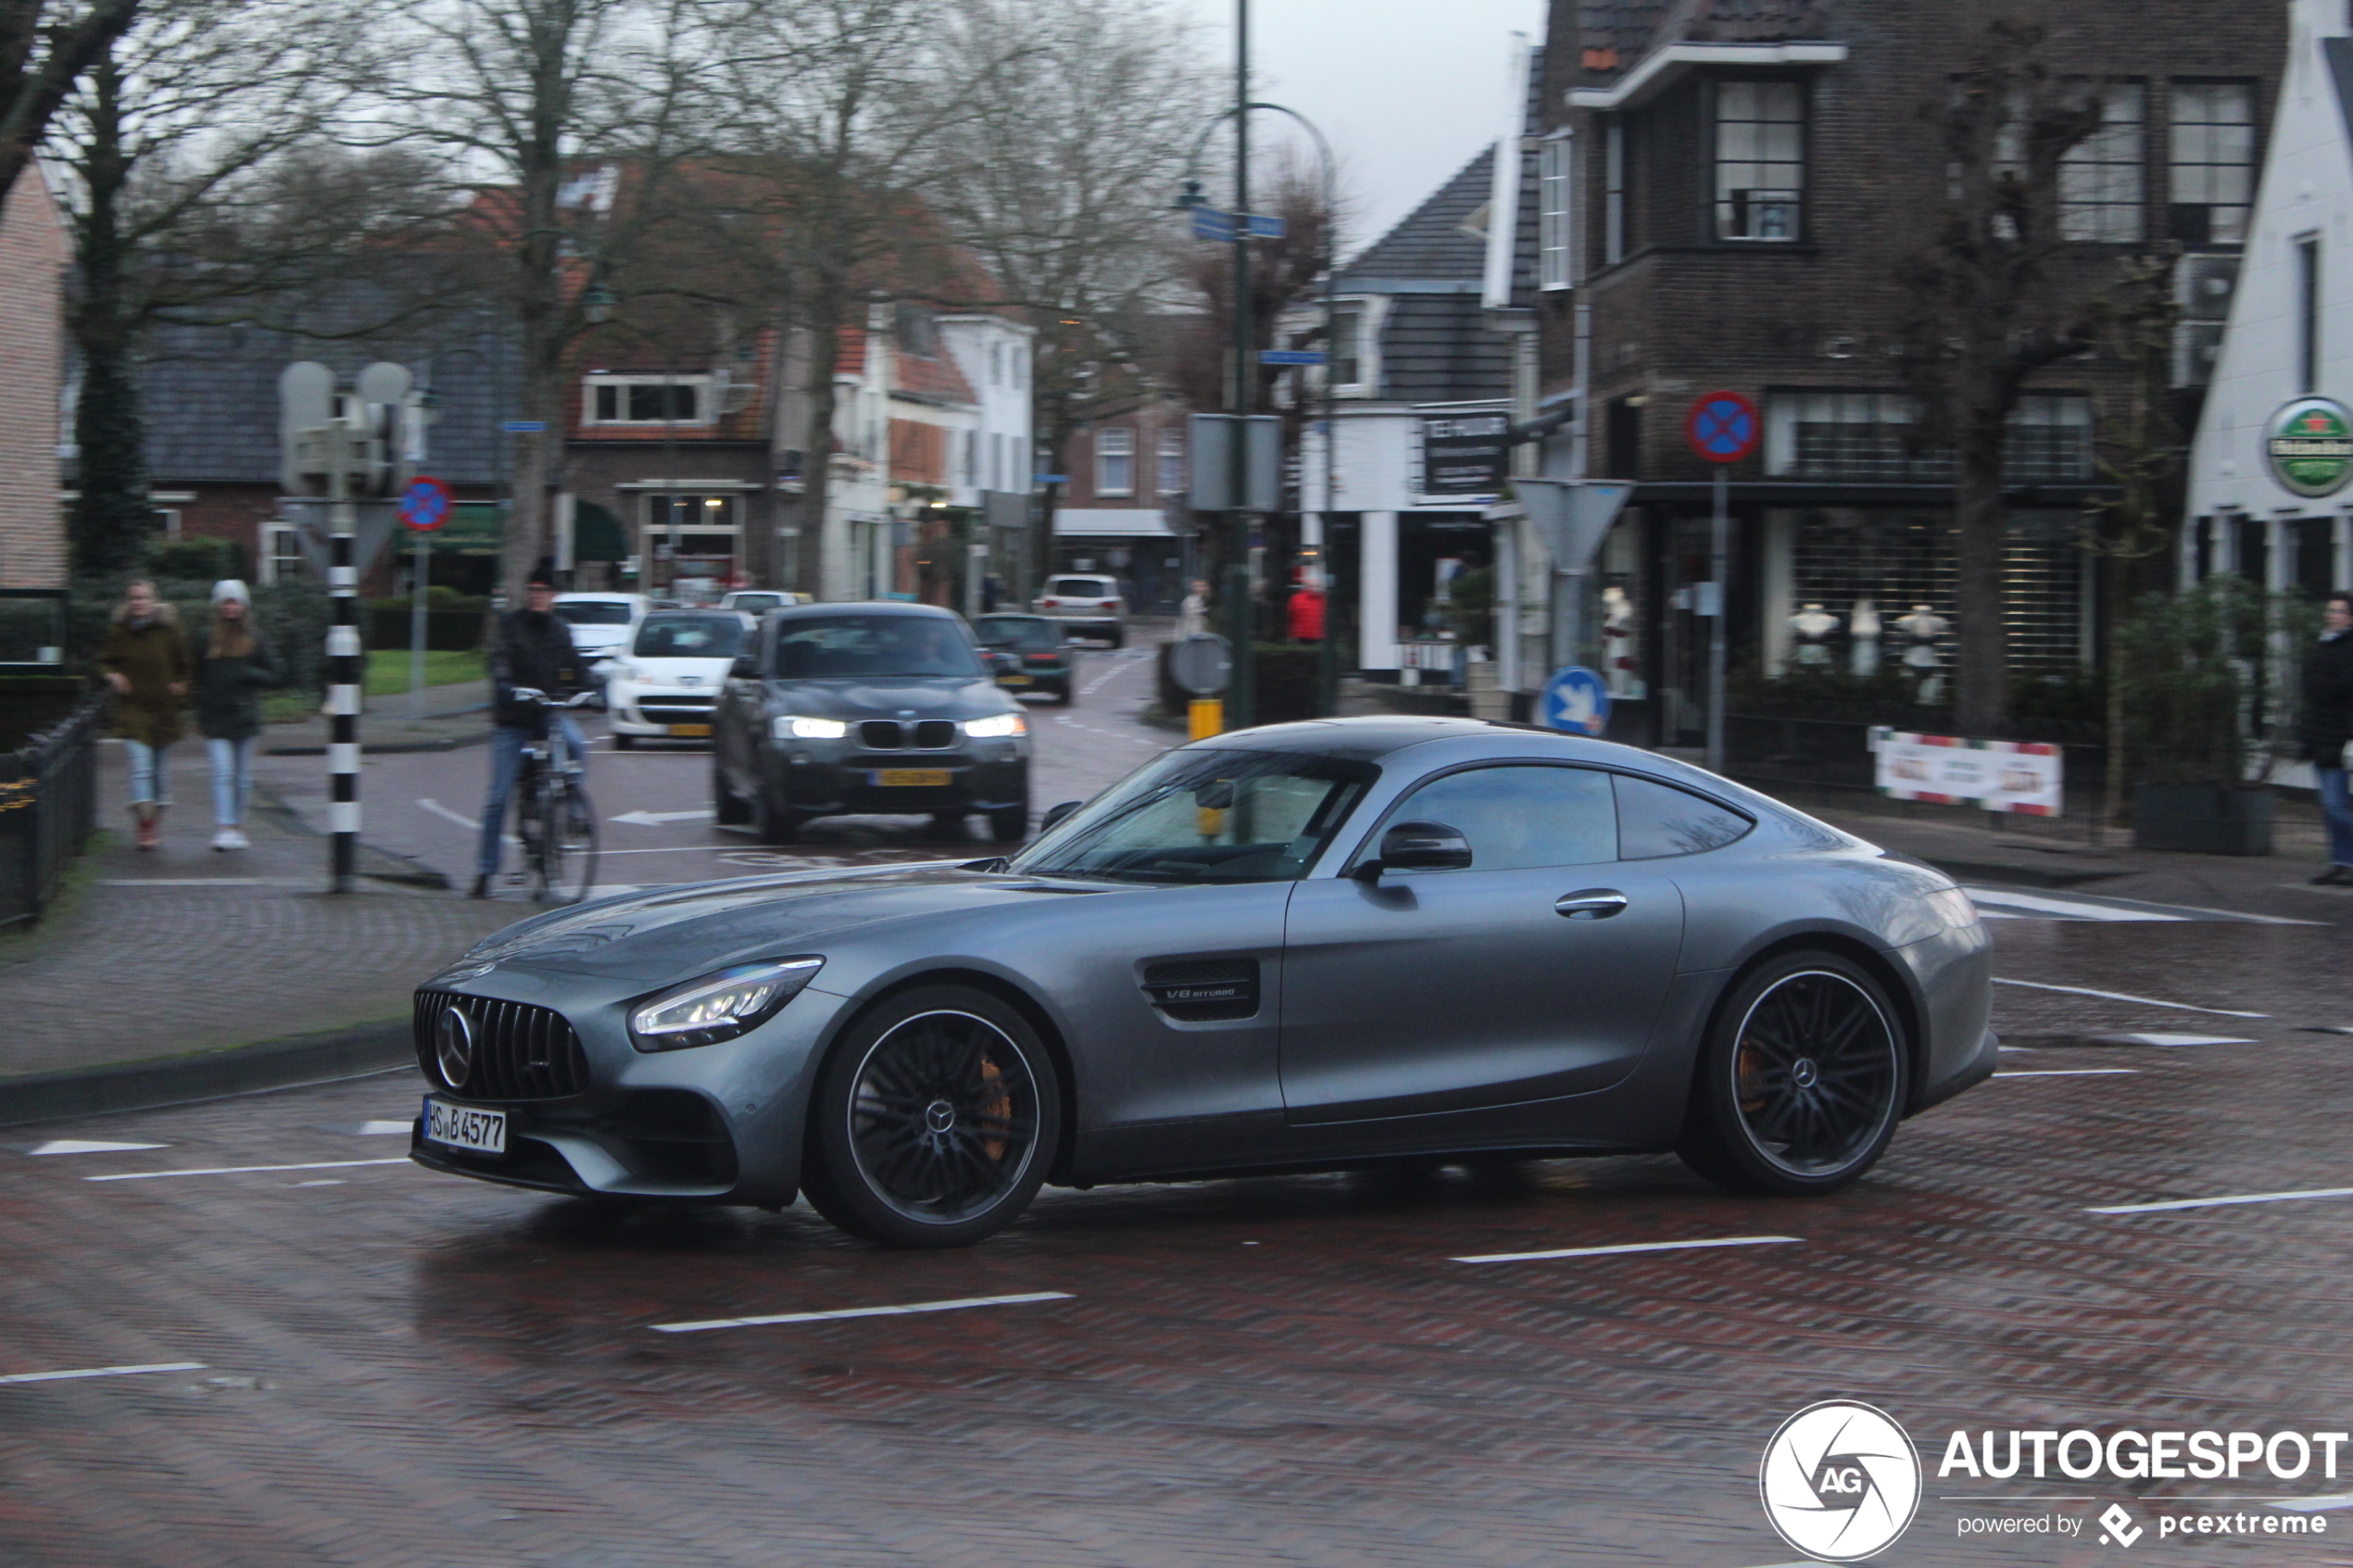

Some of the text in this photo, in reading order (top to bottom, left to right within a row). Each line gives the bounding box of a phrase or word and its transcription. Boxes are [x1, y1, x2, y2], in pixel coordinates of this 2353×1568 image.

[1165, 988, 1236, 998] V8 BITURBO
[429, 1104, 443, 1137] HS
